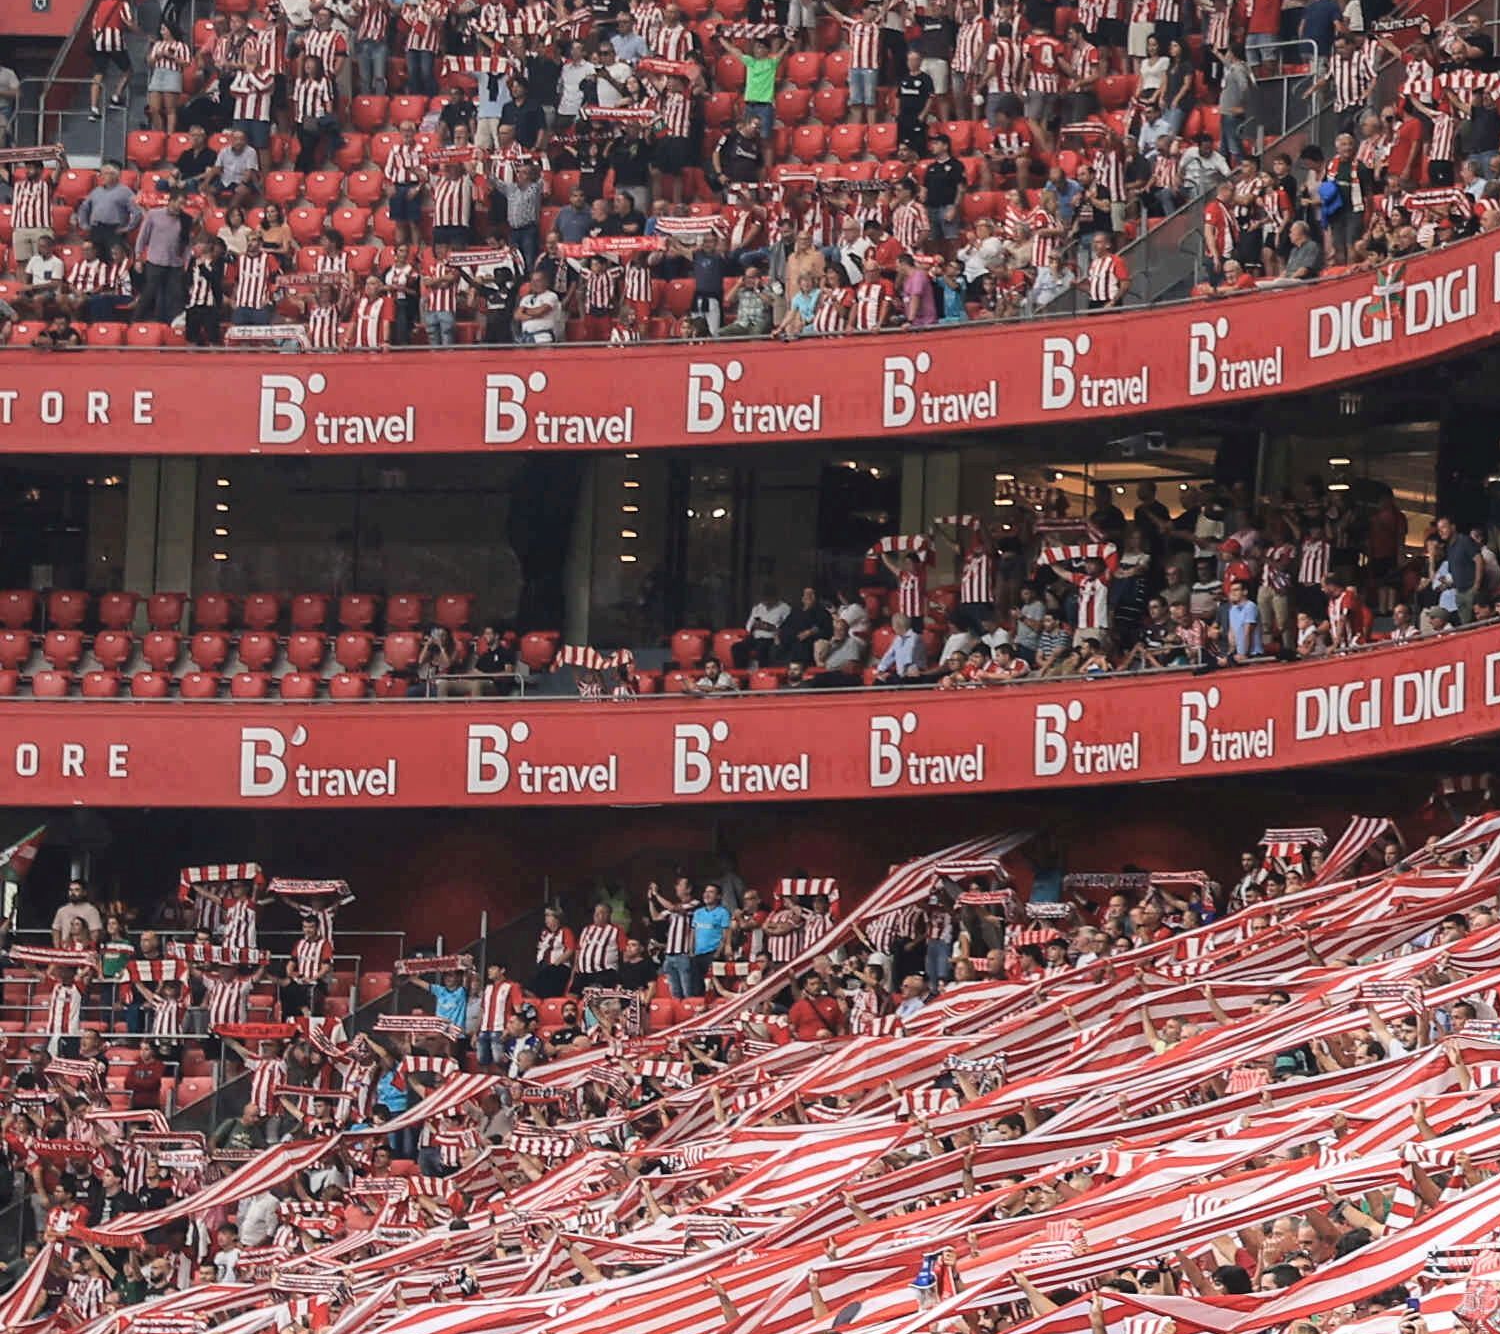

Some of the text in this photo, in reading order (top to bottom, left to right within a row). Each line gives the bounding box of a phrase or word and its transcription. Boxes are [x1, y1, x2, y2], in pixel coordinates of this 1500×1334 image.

[1405, 264, 1477, 336] DIGI
[1080, 366, 1148, 407] travel
[1220, 346, 1282, 391] travel
[731, 394, 821, 433] travel
[920, 380, 997, 424] travel
[314, 406, 414, 444] travel
[534, 406, 633, 444] travel
[1296, 678, 1382, 740] DIGI
[1393, 661, 1465, 725] DIGI
[1072, 732, 1139, 774] travel
[1211, 719, 1274, 762] travel
[295, 759, 396, 796] travel
[518, 755, 617, 793] travel
[718, 753, 808, 793] travel
[907, 744, 983, 785] travel
